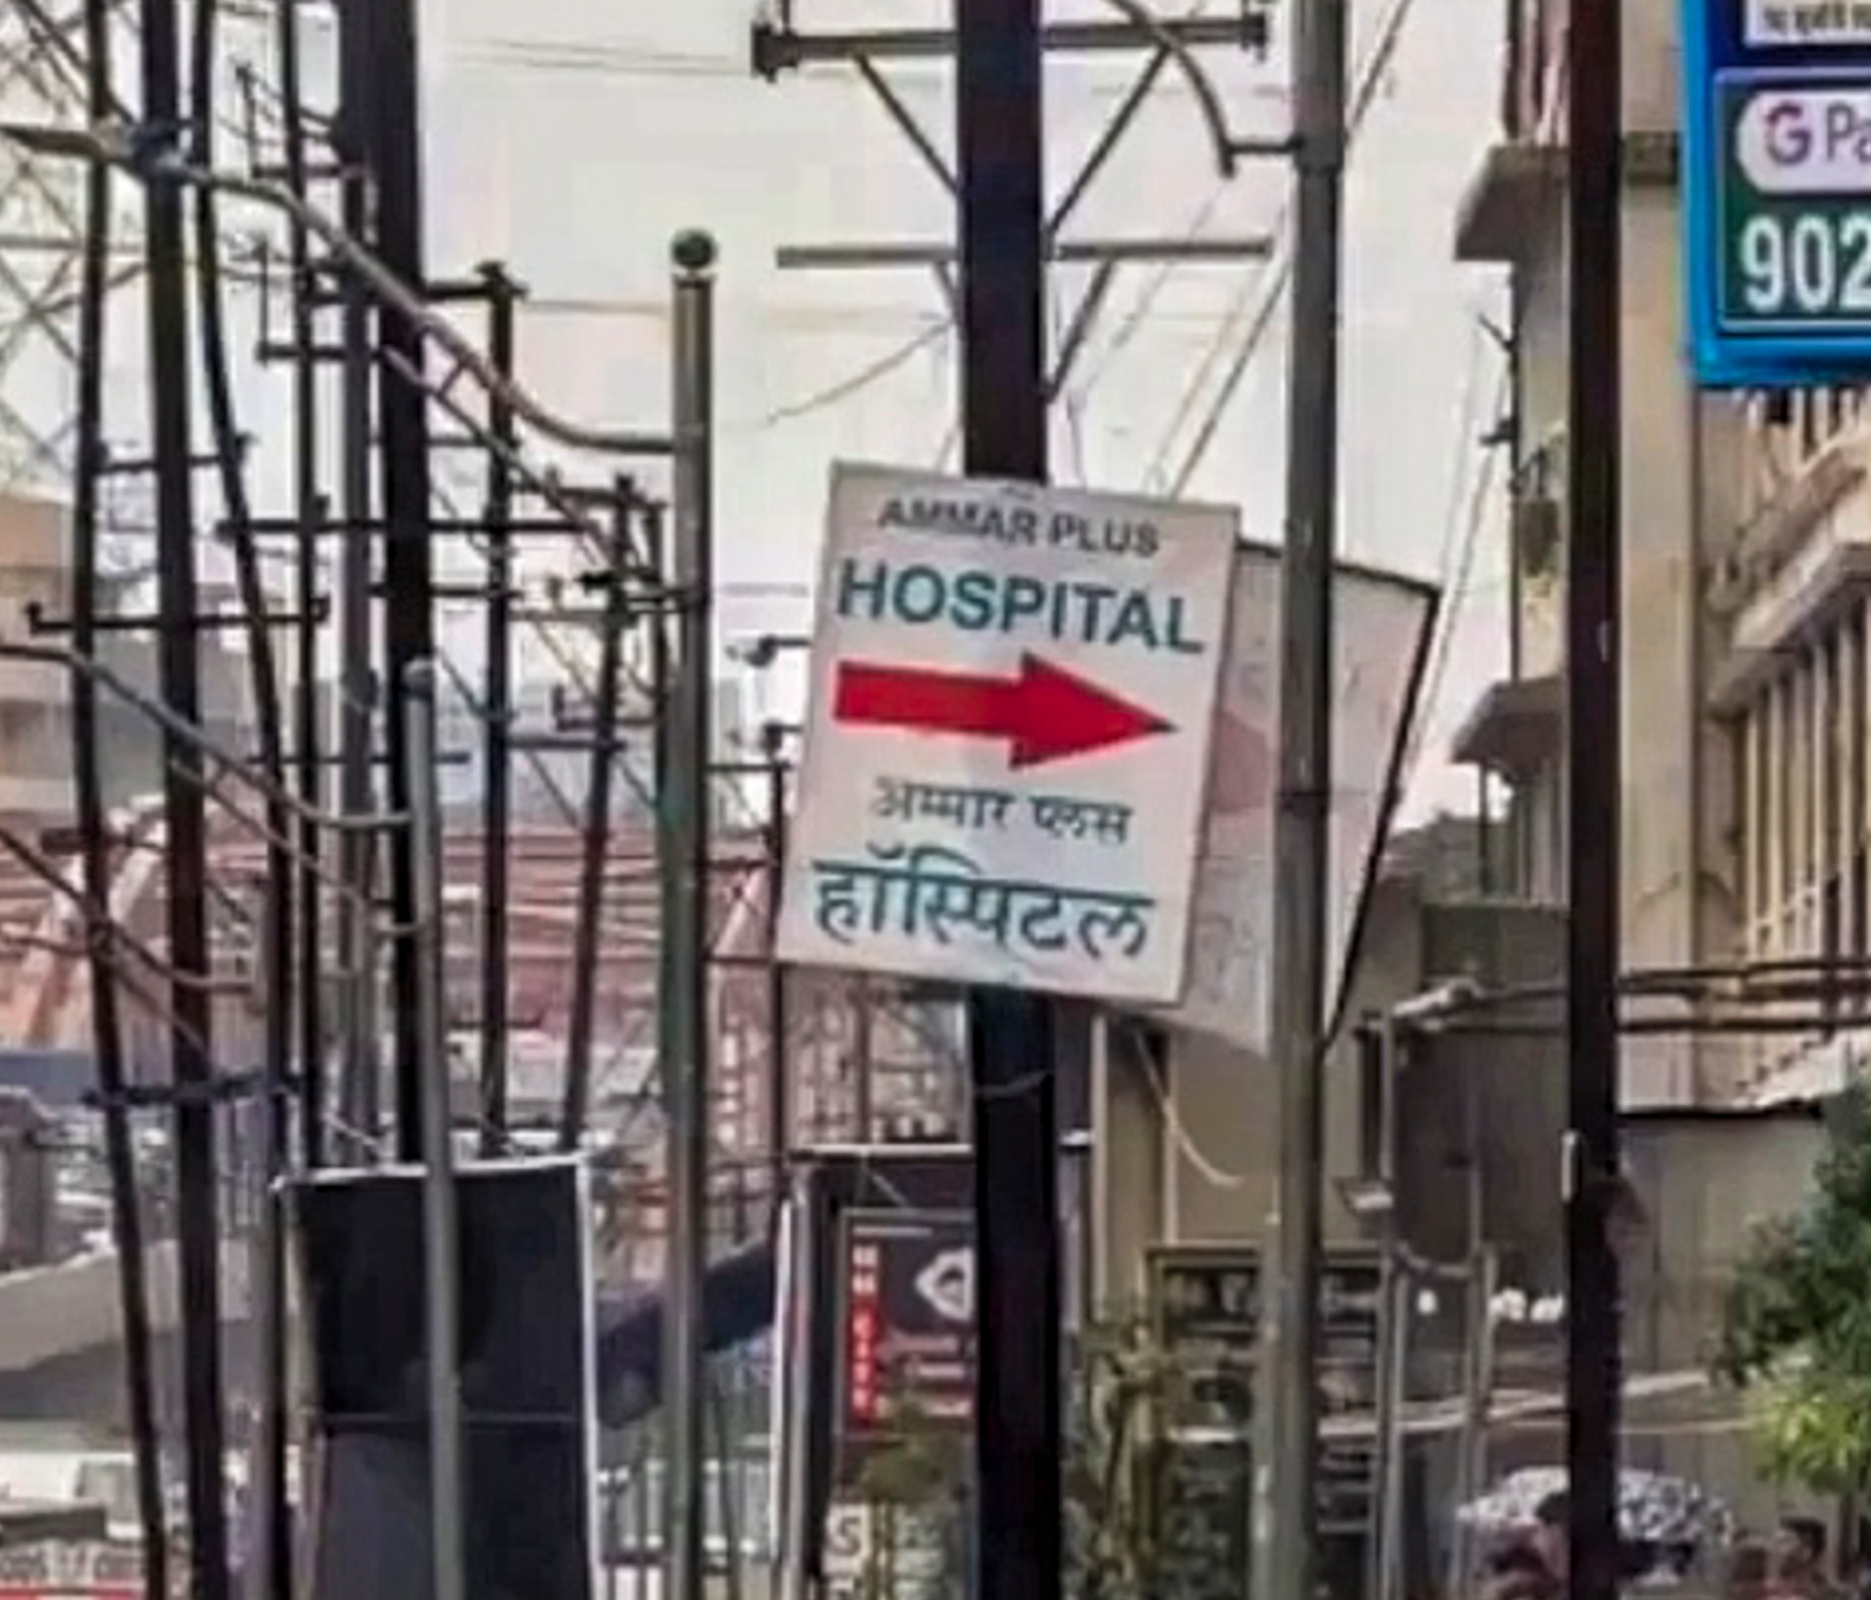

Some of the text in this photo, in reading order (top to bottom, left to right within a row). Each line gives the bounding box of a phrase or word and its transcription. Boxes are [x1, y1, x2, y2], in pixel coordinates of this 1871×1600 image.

[1766, 104, 1811, 165] G
[1741, 213, 1871, 313] 902
[876, 499, 1160, 557] AMMAR PLUS
[836, 557, 1204, 654] HOSPITAL
[873, 775, 1134, 845] अम्मार प्लस
[811, 841, 1156, 959] हॉस्पिटल
